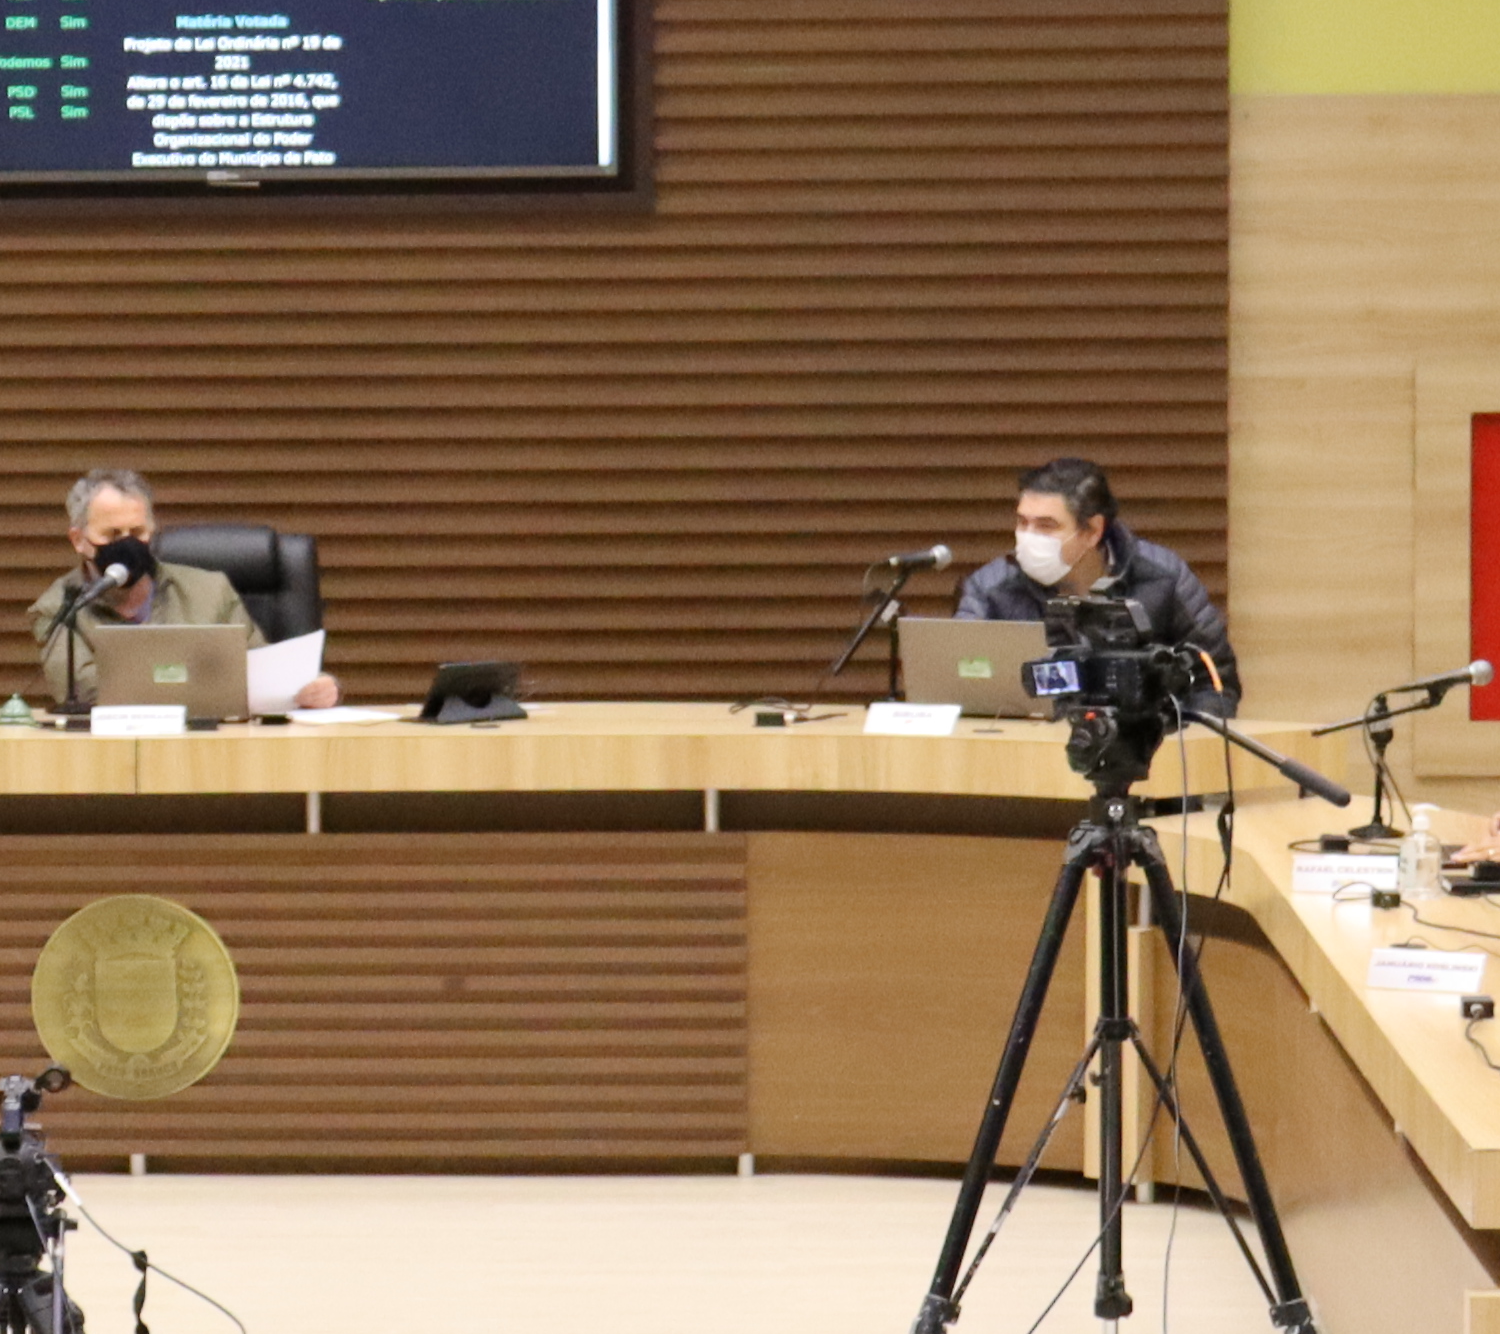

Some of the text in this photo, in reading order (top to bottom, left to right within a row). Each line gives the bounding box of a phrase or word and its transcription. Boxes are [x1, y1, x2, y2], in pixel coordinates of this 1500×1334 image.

[5, 16, 38, 30] DEM
[60, 15, 88, 29] Sim
[176, 14, 290, 29] Matéria Votada
[123, 36, 173, 54] Projeto
[174, 36, 193, 52] de
[195, 36, 216, 51] Lei
[217, 35, 281, 51] Ordinária
[302, 35, 321, 50] 19
[322, 35, 342, 50] de
[60, 55, 89, 68] Sim
[215, 55, 250, 70] 2021
[127, 75, 168, 91] Altera
[169, 77, 181, 90] o
[181, 75, 207, 90] art.
[210, 74, 229, 90] 16
[251, 74, 272, 90] Lei
[293, 72, 338, 90] 4.742,
[7, 85, 37, 99] PSD
[61, 84, 89, 98] Sim
[127, 93, 340, 110] de 29 de fevereiro de 2016, que
[9, 105, 35, 119] PSL
[61, 105, 89, 119] Sim
[152, 112, 197, 130] dispõe
[198, 113, 237, 128] sobre
[251, 112, 315, 127] Estrutura
[153, 132, 314, 150] Organizacional do Poder
[132, 152, 197, 167] Executivo
[198, 152, 217, 166] do
[219, 150, 281, 167] Município
[303, 150, 336, 165] Pato
